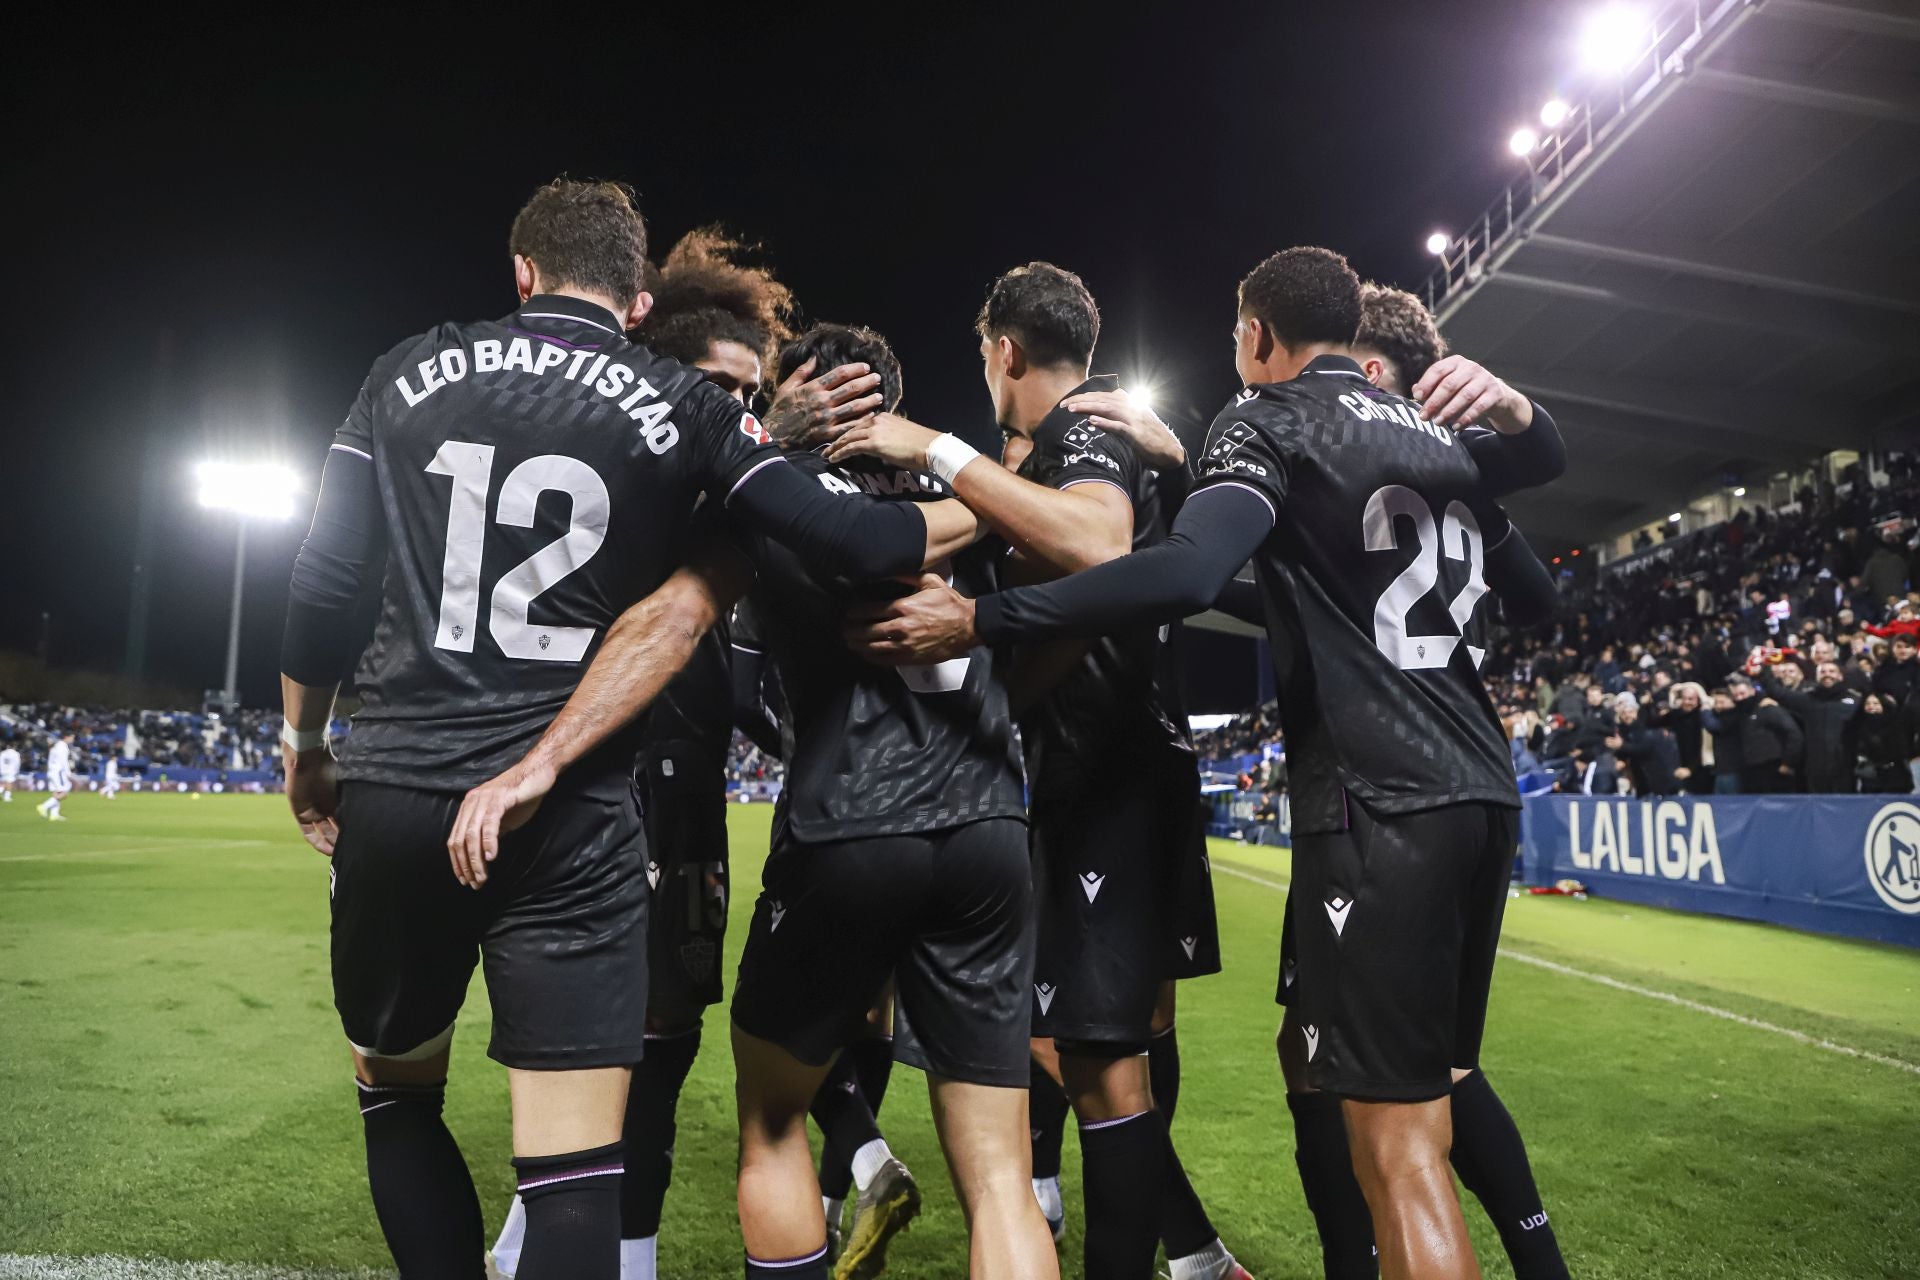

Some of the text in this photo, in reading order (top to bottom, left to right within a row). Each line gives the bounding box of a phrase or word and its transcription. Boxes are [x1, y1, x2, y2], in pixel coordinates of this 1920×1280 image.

[395, 338, 680, 455] LEO BAPTISTAO
[1338, 391, 1452, 447] CHRINO
[424, 439, 611, 661] 12
[1363, 484, 1487, 671] 22
[1569, 800, 1726, 885] LALIGA
